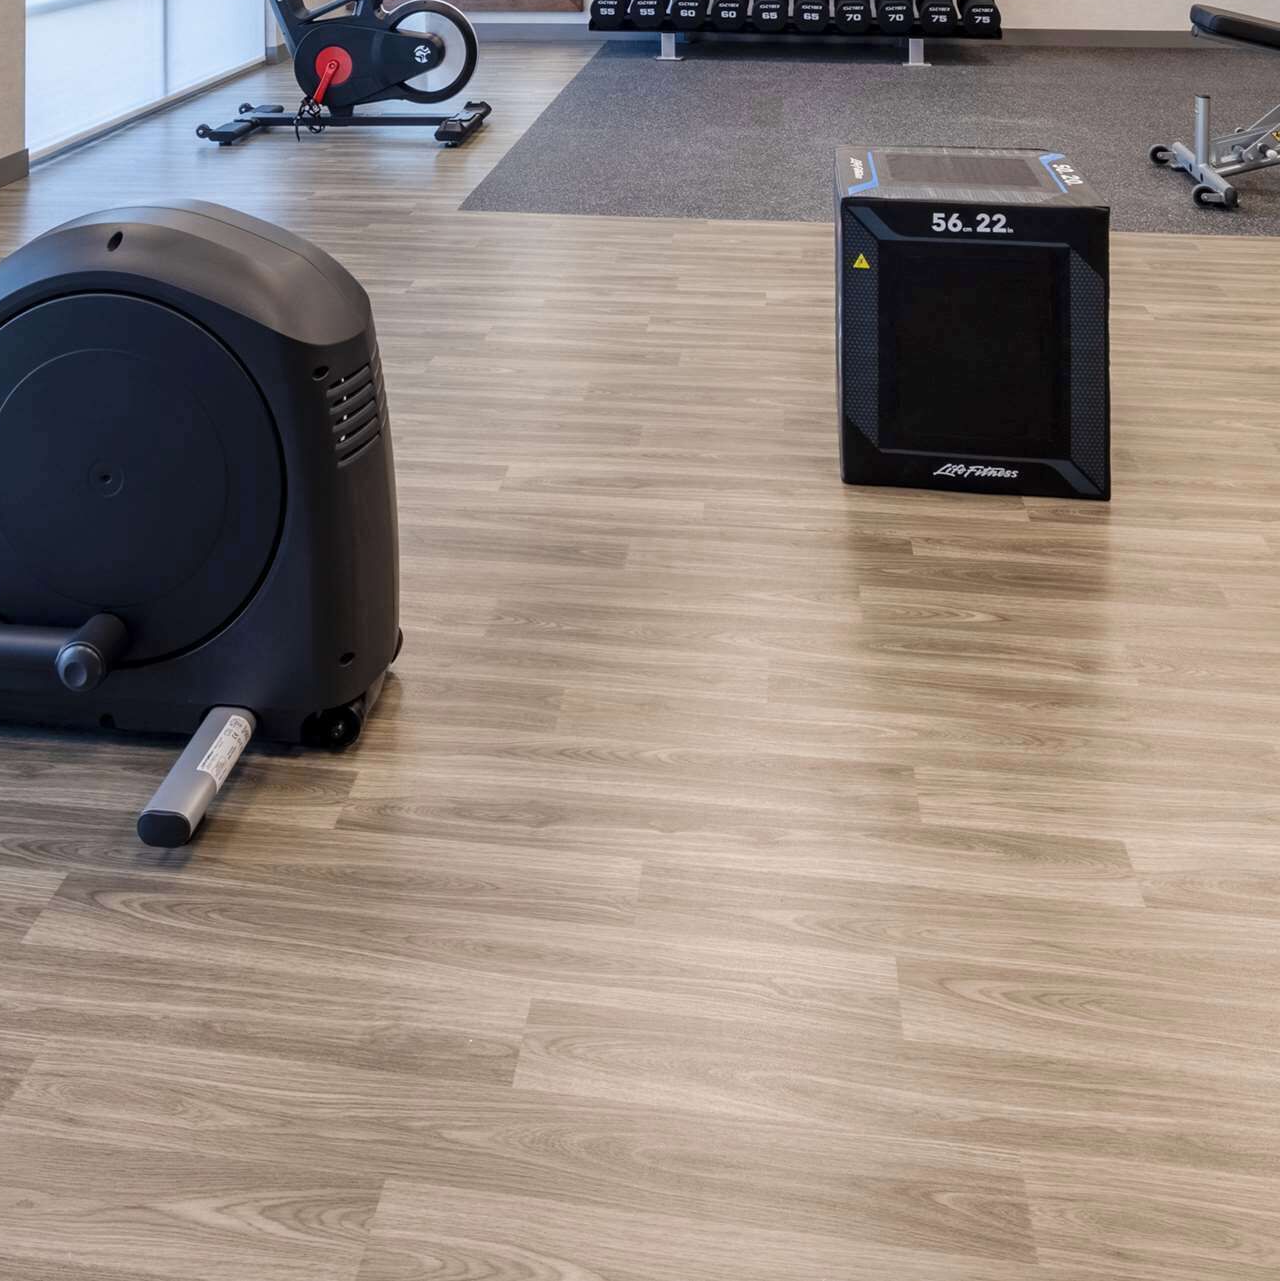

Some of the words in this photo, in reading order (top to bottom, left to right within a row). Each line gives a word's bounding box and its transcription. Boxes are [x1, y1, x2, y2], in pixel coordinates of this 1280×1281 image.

[931, 212, 963, 232] 56
[976, 213, 1007, 233] 22
[933, 463, 966, 477] Life
[963, 465, 1019, 478] Fitness
